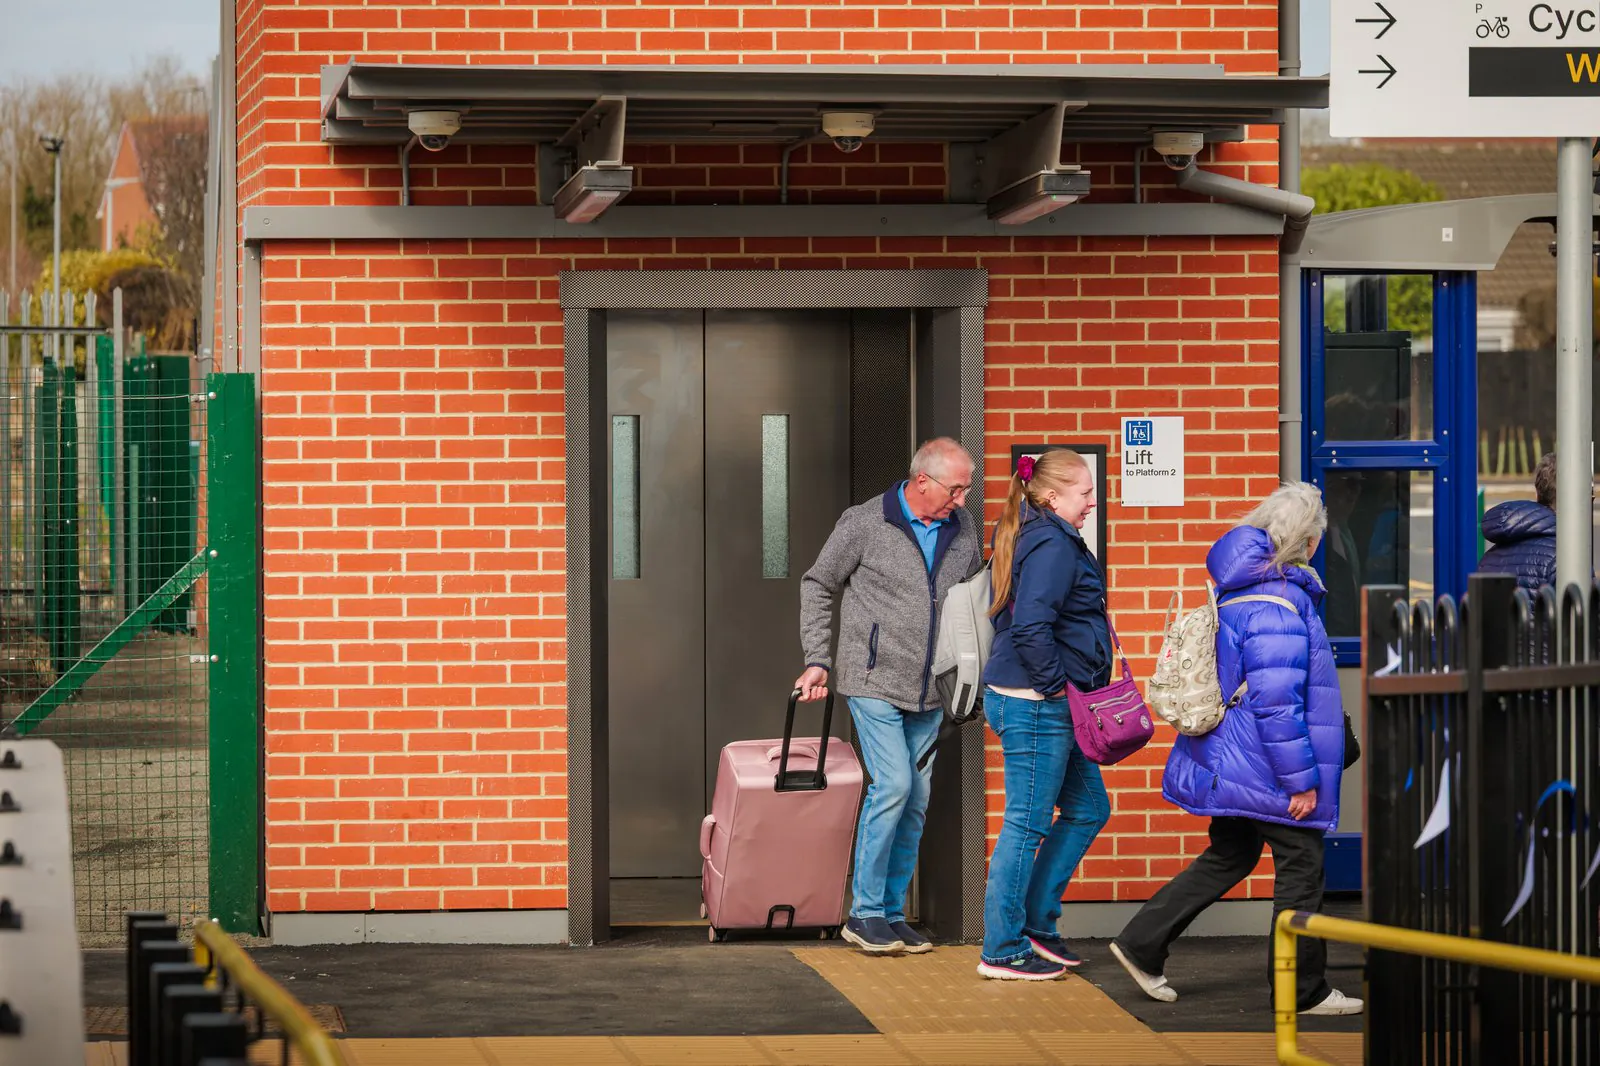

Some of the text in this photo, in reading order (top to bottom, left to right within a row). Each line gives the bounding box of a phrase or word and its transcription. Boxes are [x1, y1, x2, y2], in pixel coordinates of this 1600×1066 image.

[1475, 3, 1483, 14] P
[1528, 3, 1600, 40] Cyc
[1125, 449, 1153, 465] Lift
[1125, 468, 1176, 477] to Platform 2
